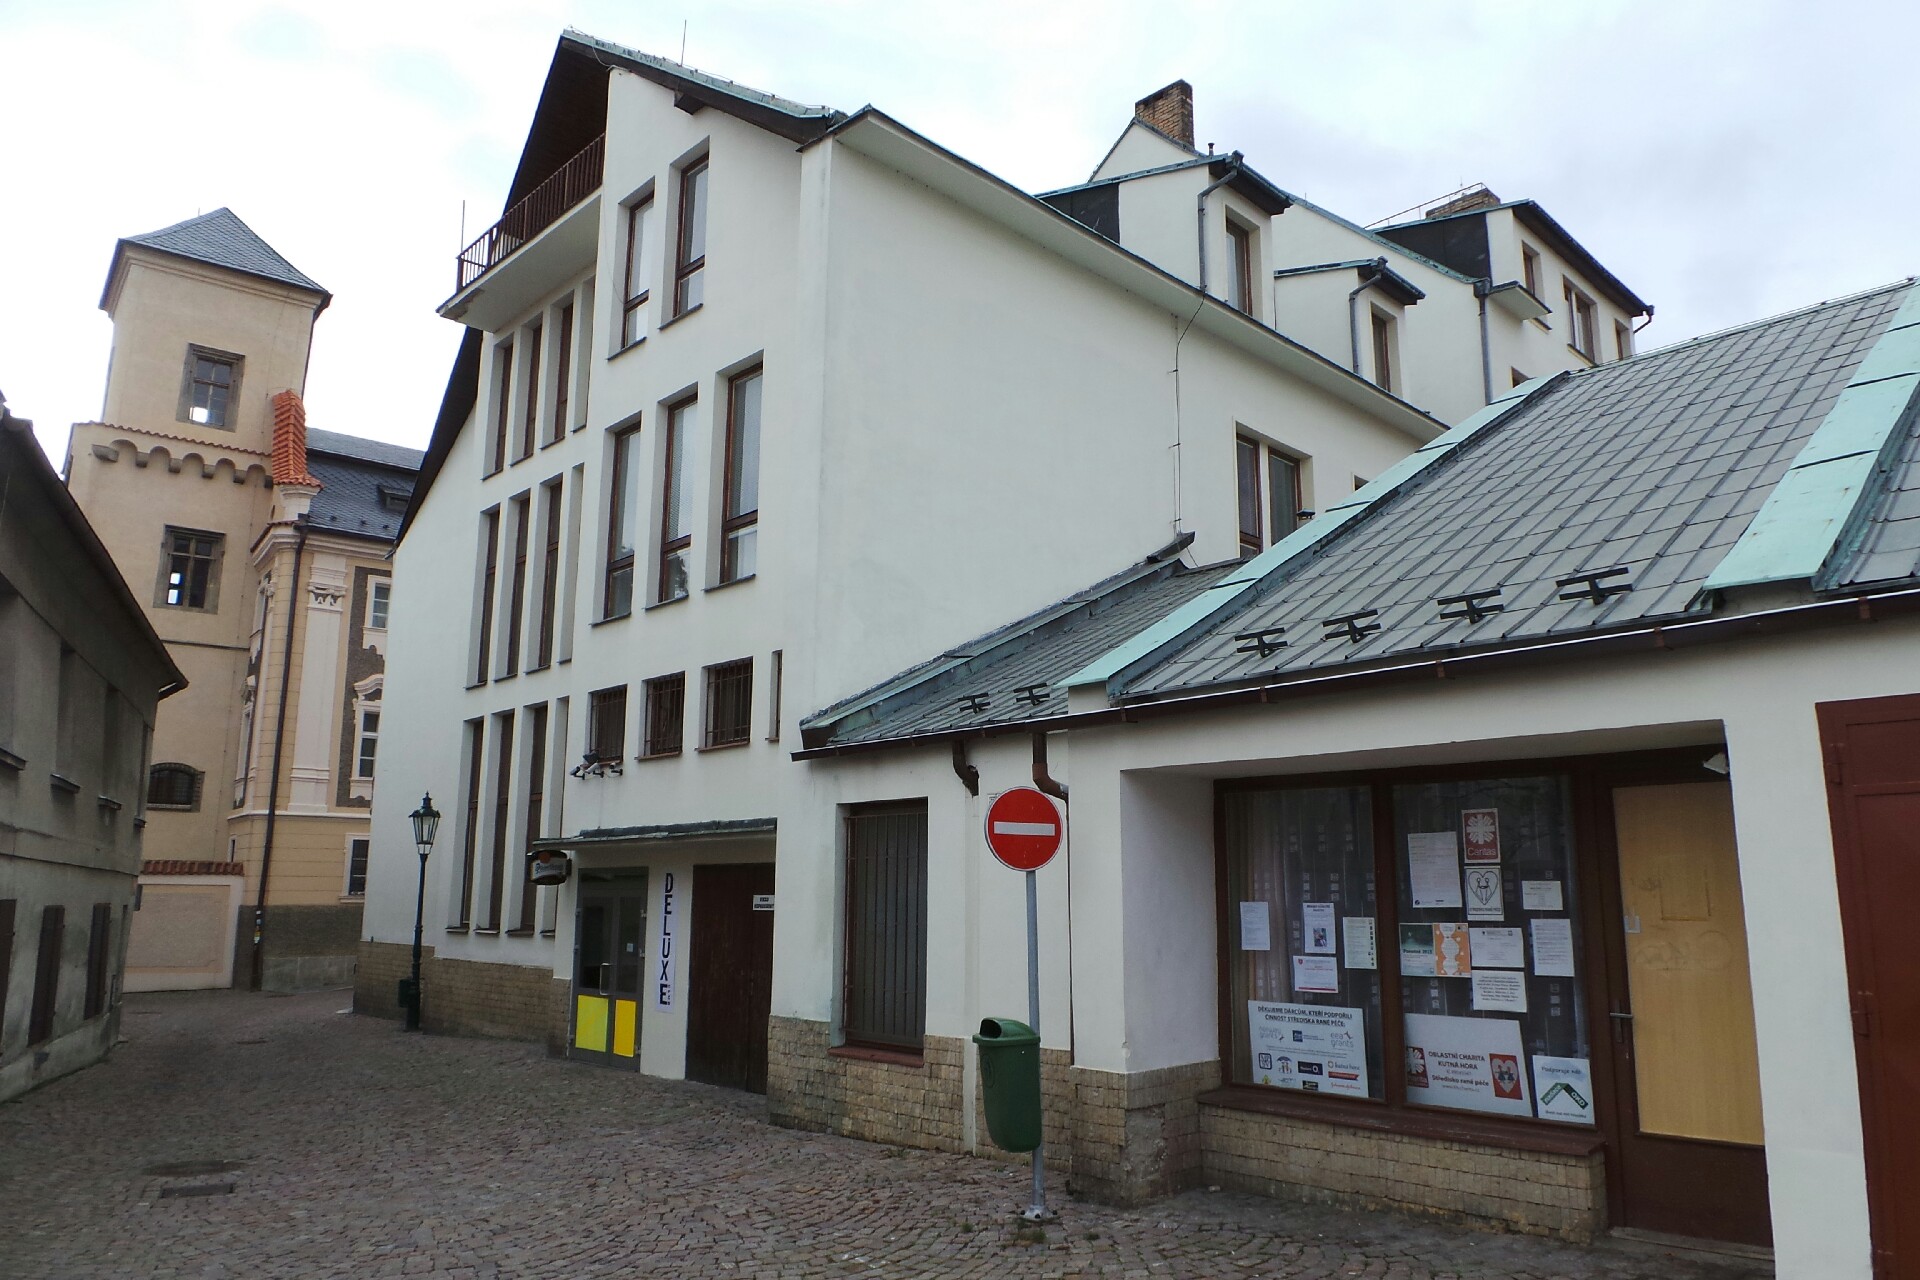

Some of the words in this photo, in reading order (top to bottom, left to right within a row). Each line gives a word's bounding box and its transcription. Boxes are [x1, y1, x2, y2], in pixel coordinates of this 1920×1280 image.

[1467, 847, 1497, 857] Caritas
[660, 872, 674, 1006] DELUXE
[1331, 1039, 1354, 1049] grants
[1428, 1050, 1458, 1060] OBLASTNÍ
[1459, 1053, 1486, 1062] CHARITA
[1437, 1060, 1460, 1069] KUTNÁ
[1460, 1062, 1479, 1070] HORA
[1432, 1074, 1459, 1084] Středisko
[1474, 1079, 1489, 1087] péče
